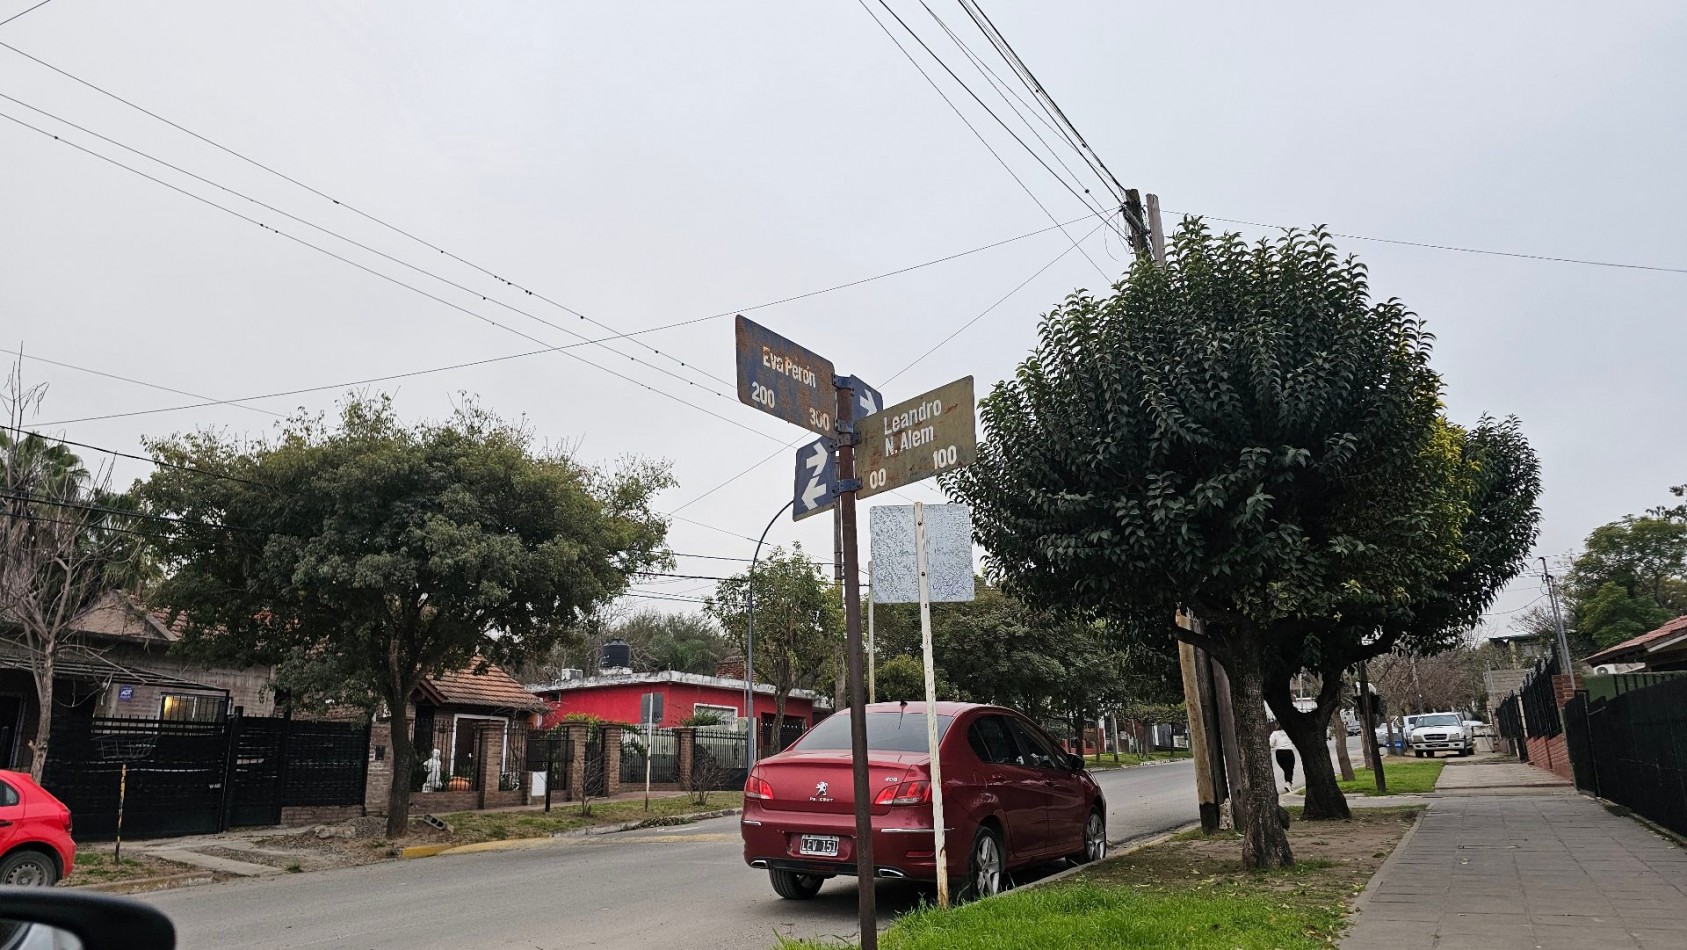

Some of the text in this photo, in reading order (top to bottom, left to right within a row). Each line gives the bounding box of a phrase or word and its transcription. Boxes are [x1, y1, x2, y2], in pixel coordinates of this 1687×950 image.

[763, 346, 816, 388] Eva Perón
[752, 381, 830, 431] 200 300
[884, 399, 942, 435] Leandro
[885, 425, 934, 457] N. Alem
[869, 445, 957, 489] 00 100
[802, 840, 836, 852] LEV 151
